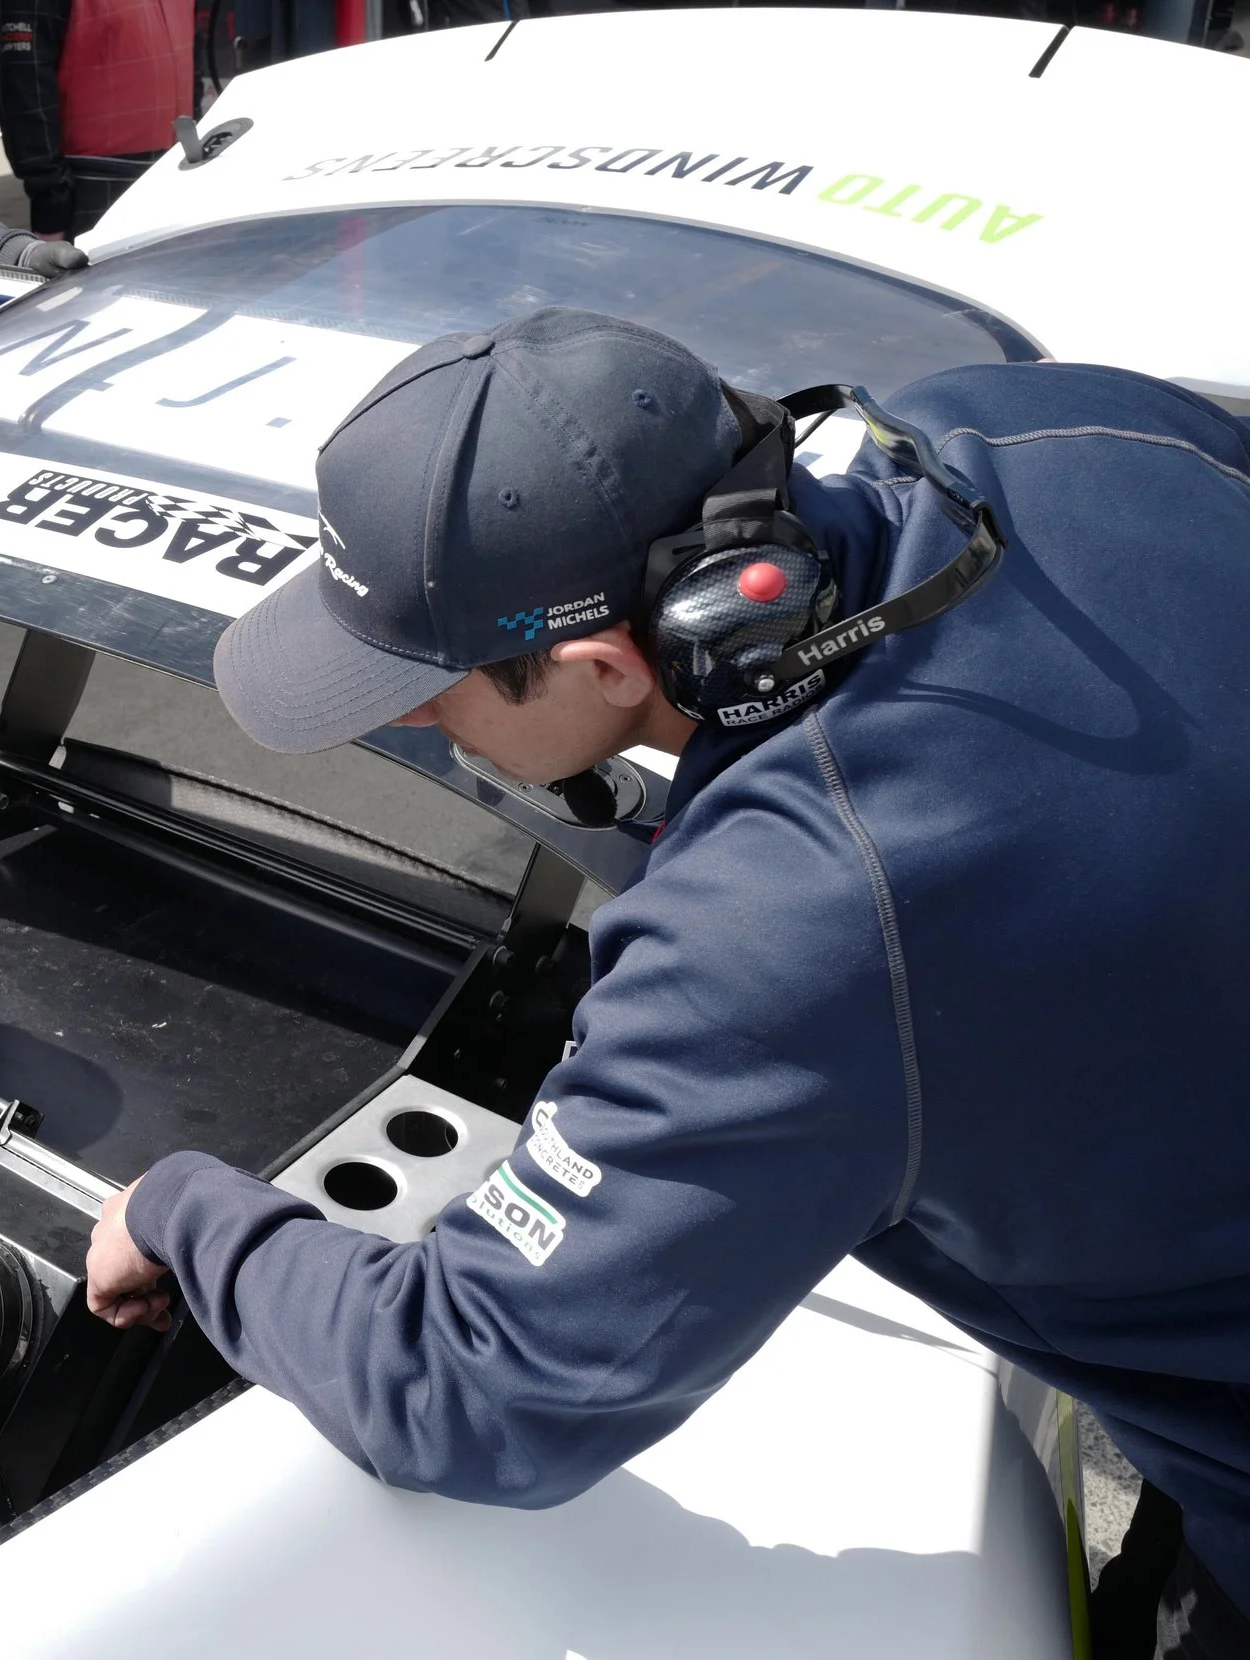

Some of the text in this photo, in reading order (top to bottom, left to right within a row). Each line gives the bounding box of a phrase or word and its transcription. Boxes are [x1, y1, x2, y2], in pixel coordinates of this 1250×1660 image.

[281, 145, 1045, 244] AUTO WINDSCREENS
[27, 471, 149, 505] PRODUCTS
[323, 552, 369, 597] Racing
[546, 592, 605, 617] JORDAN
[547, 605, 610, 630] MICHELS
[798, 615, 886, 667] Harris
[722, 673, 823, 719] HARRIS
[726, 711, 771, 726] RACE
[483, 1183, 556, 1251] SON
